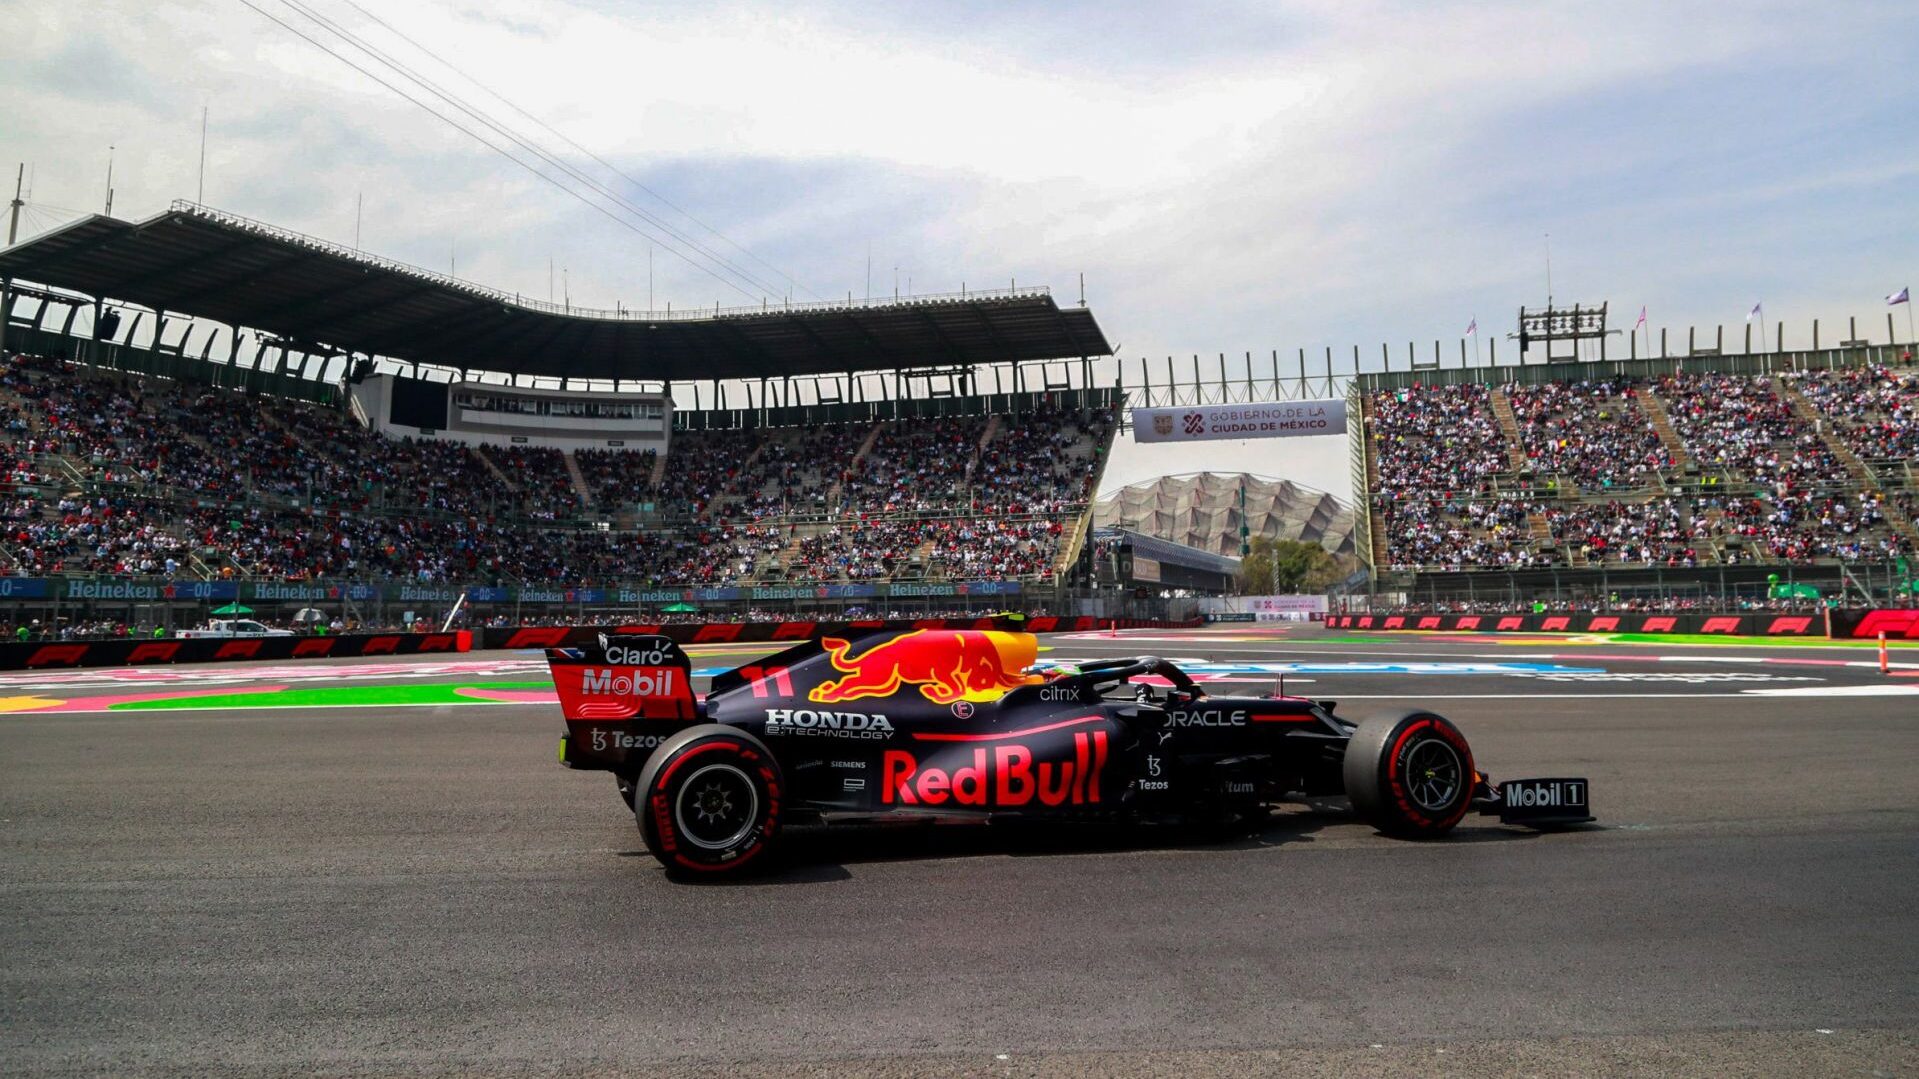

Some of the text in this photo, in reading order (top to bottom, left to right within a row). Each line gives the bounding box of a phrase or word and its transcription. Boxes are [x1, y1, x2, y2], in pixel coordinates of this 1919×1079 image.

[1210, 407, 1326, 422] GOBIERNO DE LA
[1211, 418, 1327, 433] CIUDAD DE MÉXICO
[68, 579, 158, 599] Heineken
[255, 583, 325, 600] Heineken
[518, 590, 563, 602] Heineken
[619, 590, 681, 602] Heineken
[753, 588, 814, 600] Heineken
[890, 584, 954, 597] Heineken
[582, 669, 673, 696] Mobil
[740, 667, 795, 698] 11
[1040, 685, 1080, 701] citrix
[765, 709, 895, 731] HONDA
[612, 730, 667, 748] Tezos
[831, 761, 866, 769] SIEMENS
[882, 730, 1108, 807] Red Bull
[1139, 779, 1169, 790] Tezos
[1506, 782, 1561, 807] Mobil
